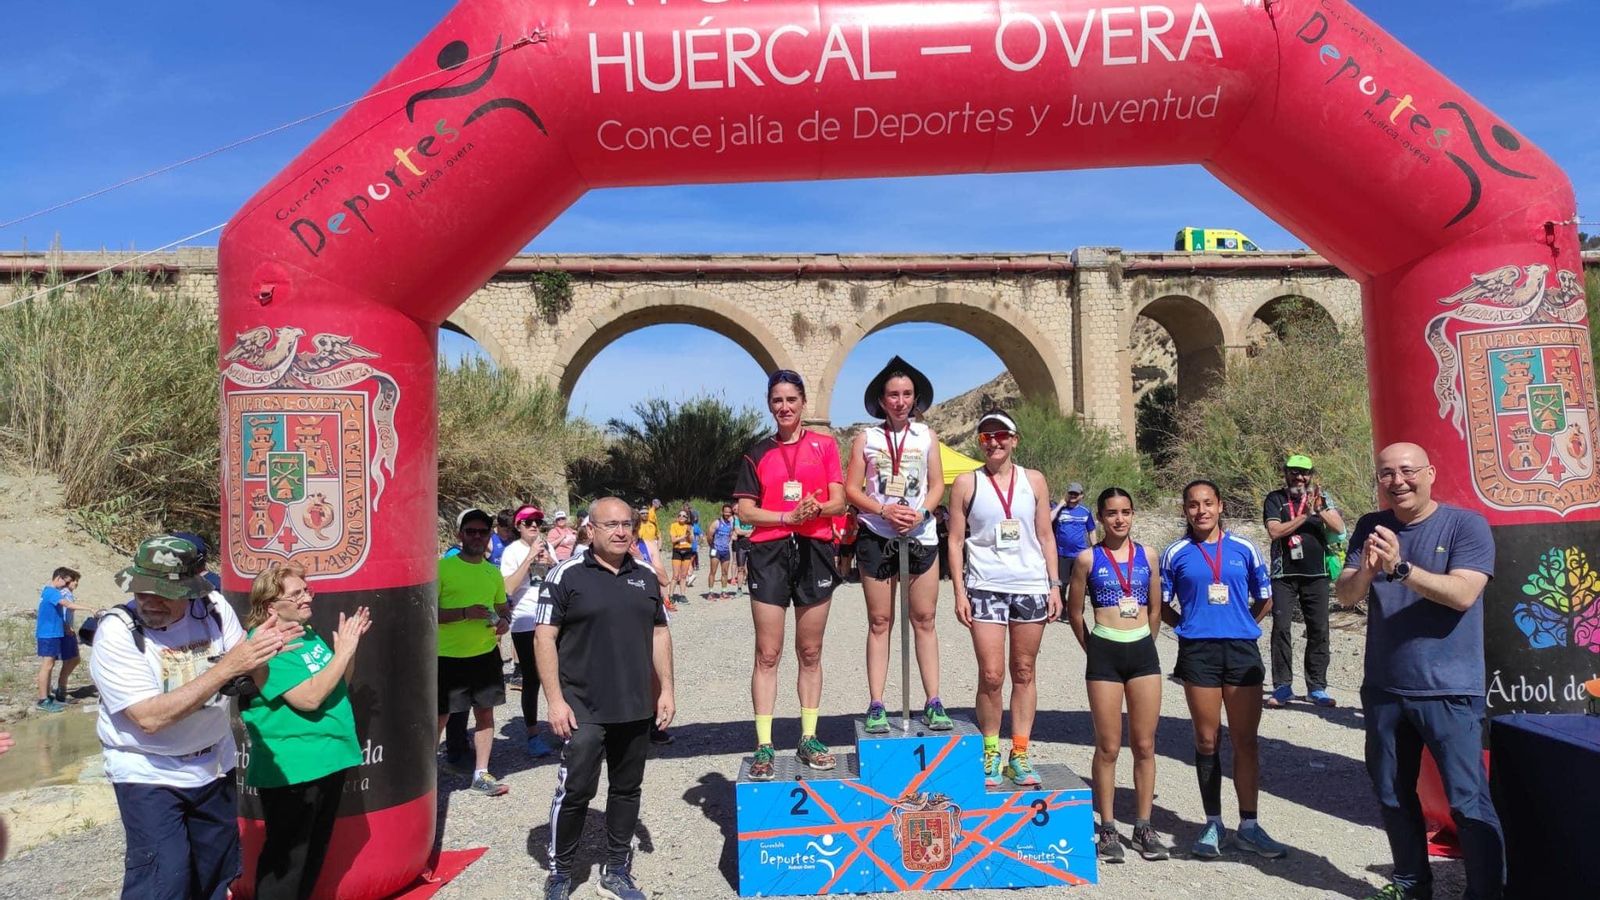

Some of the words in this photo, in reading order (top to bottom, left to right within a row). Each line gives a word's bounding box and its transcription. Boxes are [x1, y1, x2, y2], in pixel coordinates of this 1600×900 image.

[588, 16, 897, 94] HUÉRCAL
[995, 2, 1224, 72] OVERA
[1296, 11, 1450, 150] Deportes
[597, 112, 784, 153] Concejalía
[798, 110, 841, 142] de
[853, 102, 1014, 144] Deportes
[1026, 104, 1049, 137] y
[1062, 85, 1222, 127] Juventud
[289, 119, 460, 258] Deportes
[1486, 670, 1556, 708] Árbol
[1563, 674, 1586, 701] de
[913, 743, 927, 772] 1
[790, 787, 810, 816] 2
[1031, 799, 1051, 827] 3
[760, 850, 816, 870] Deportes
